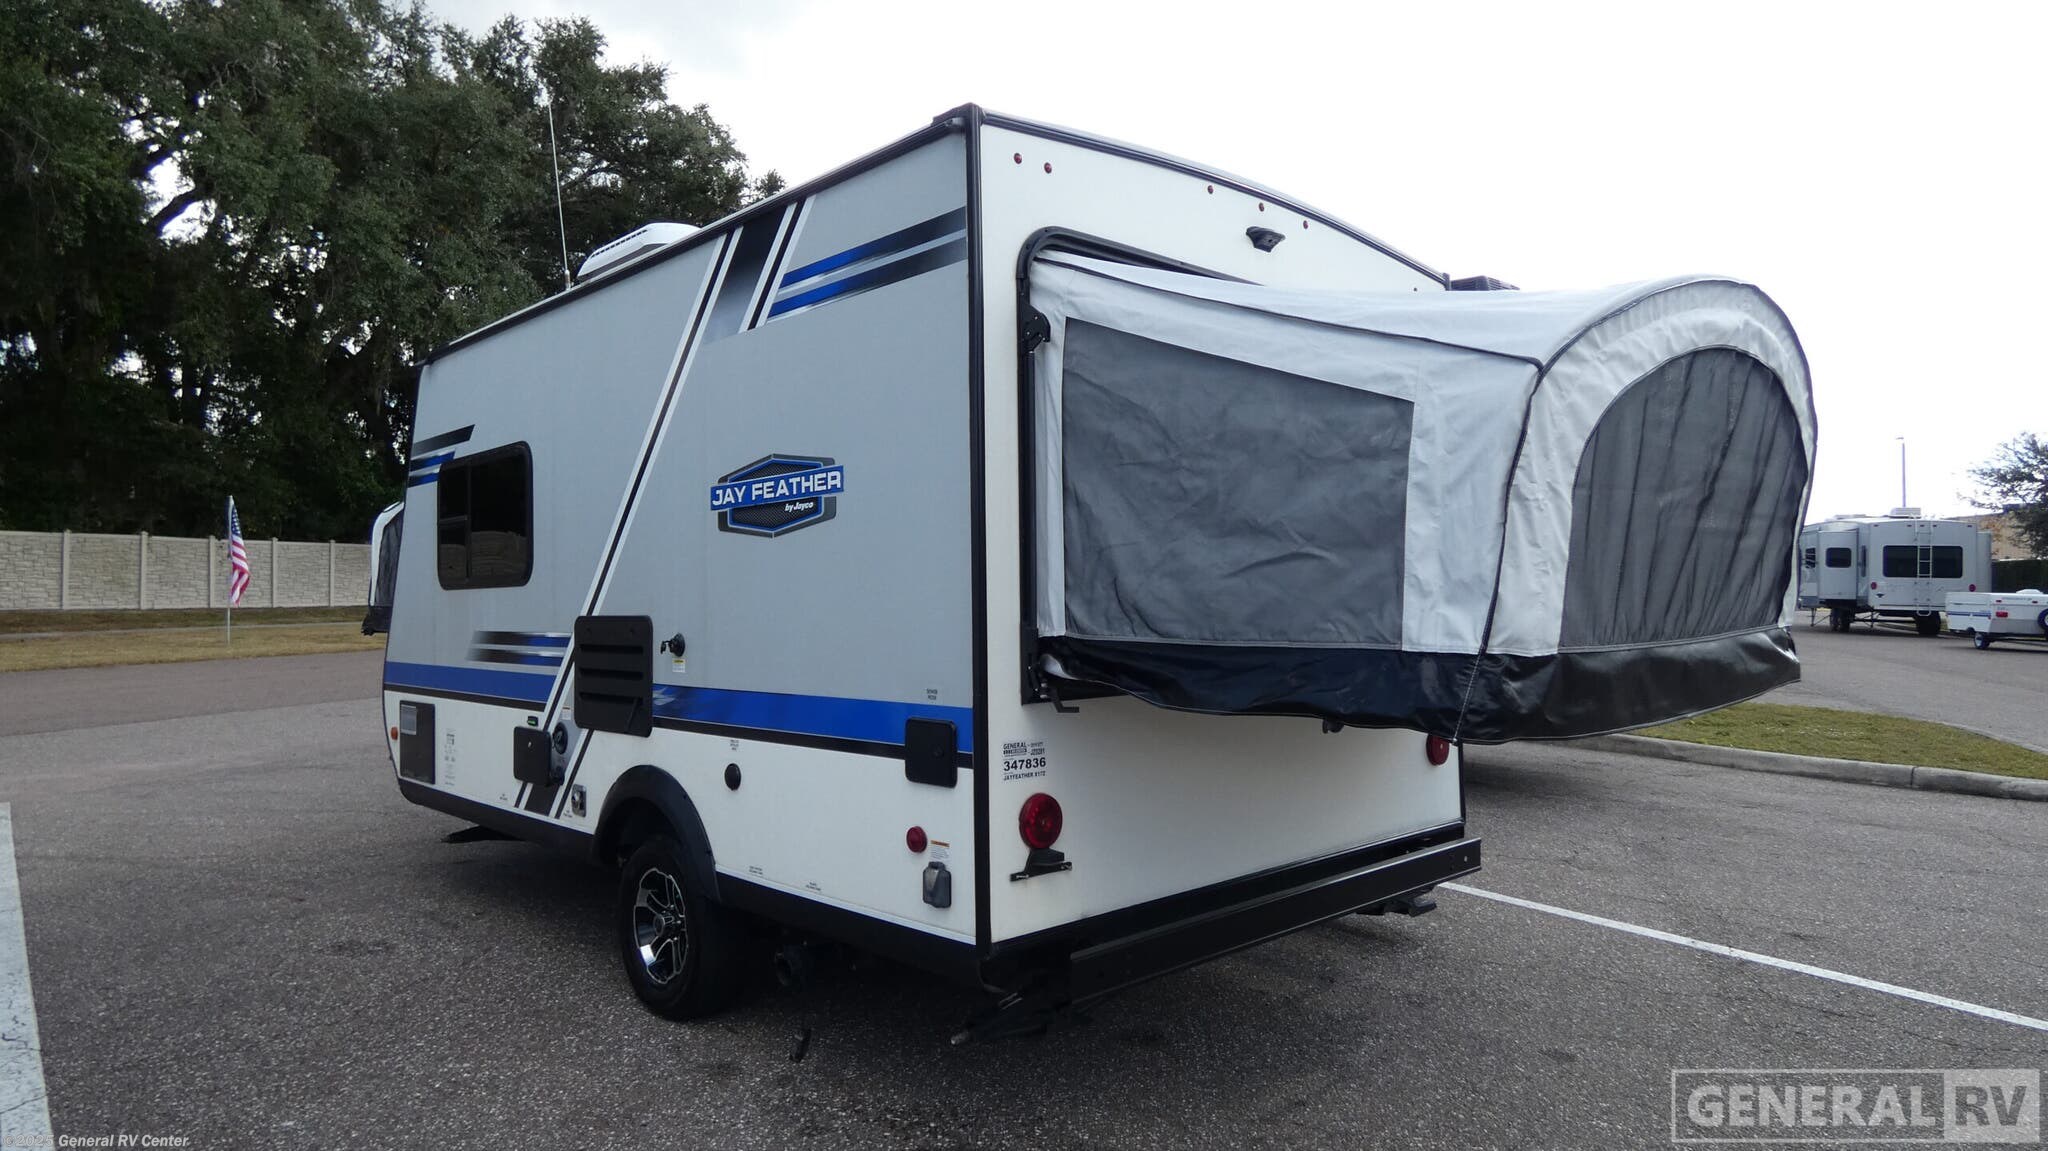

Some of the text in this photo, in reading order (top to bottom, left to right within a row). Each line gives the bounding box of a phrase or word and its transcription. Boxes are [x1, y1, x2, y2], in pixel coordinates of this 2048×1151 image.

[712, 471, 841, 506] JAY FEATHER
[785, 501, 814, 512] by Jayco
[1003, 742, 1027, 750] GENERAL
[1003, 757, 1046, 772] 347836
